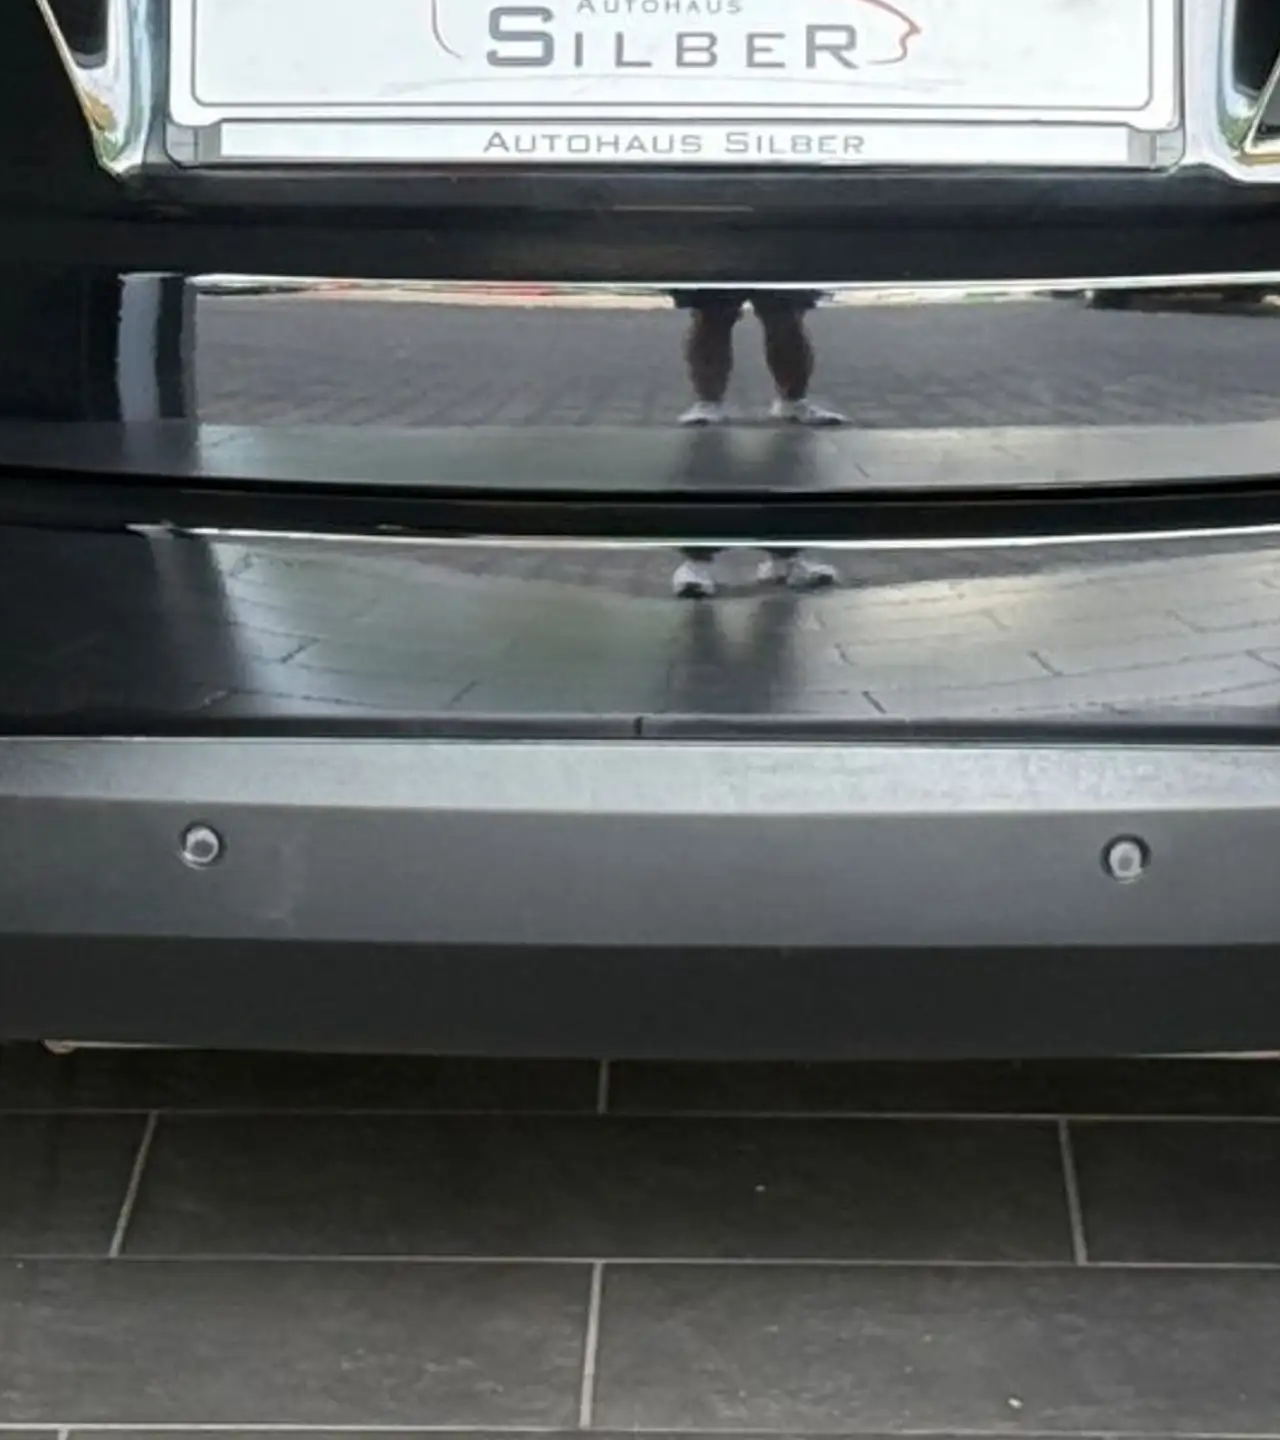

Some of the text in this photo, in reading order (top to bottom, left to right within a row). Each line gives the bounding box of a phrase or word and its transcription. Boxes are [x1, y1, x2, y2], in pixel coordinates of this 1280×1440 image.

[485, 5, 860, 70] SILBER
[482, 130, 866, 156] AUTOHAUS SILBER
